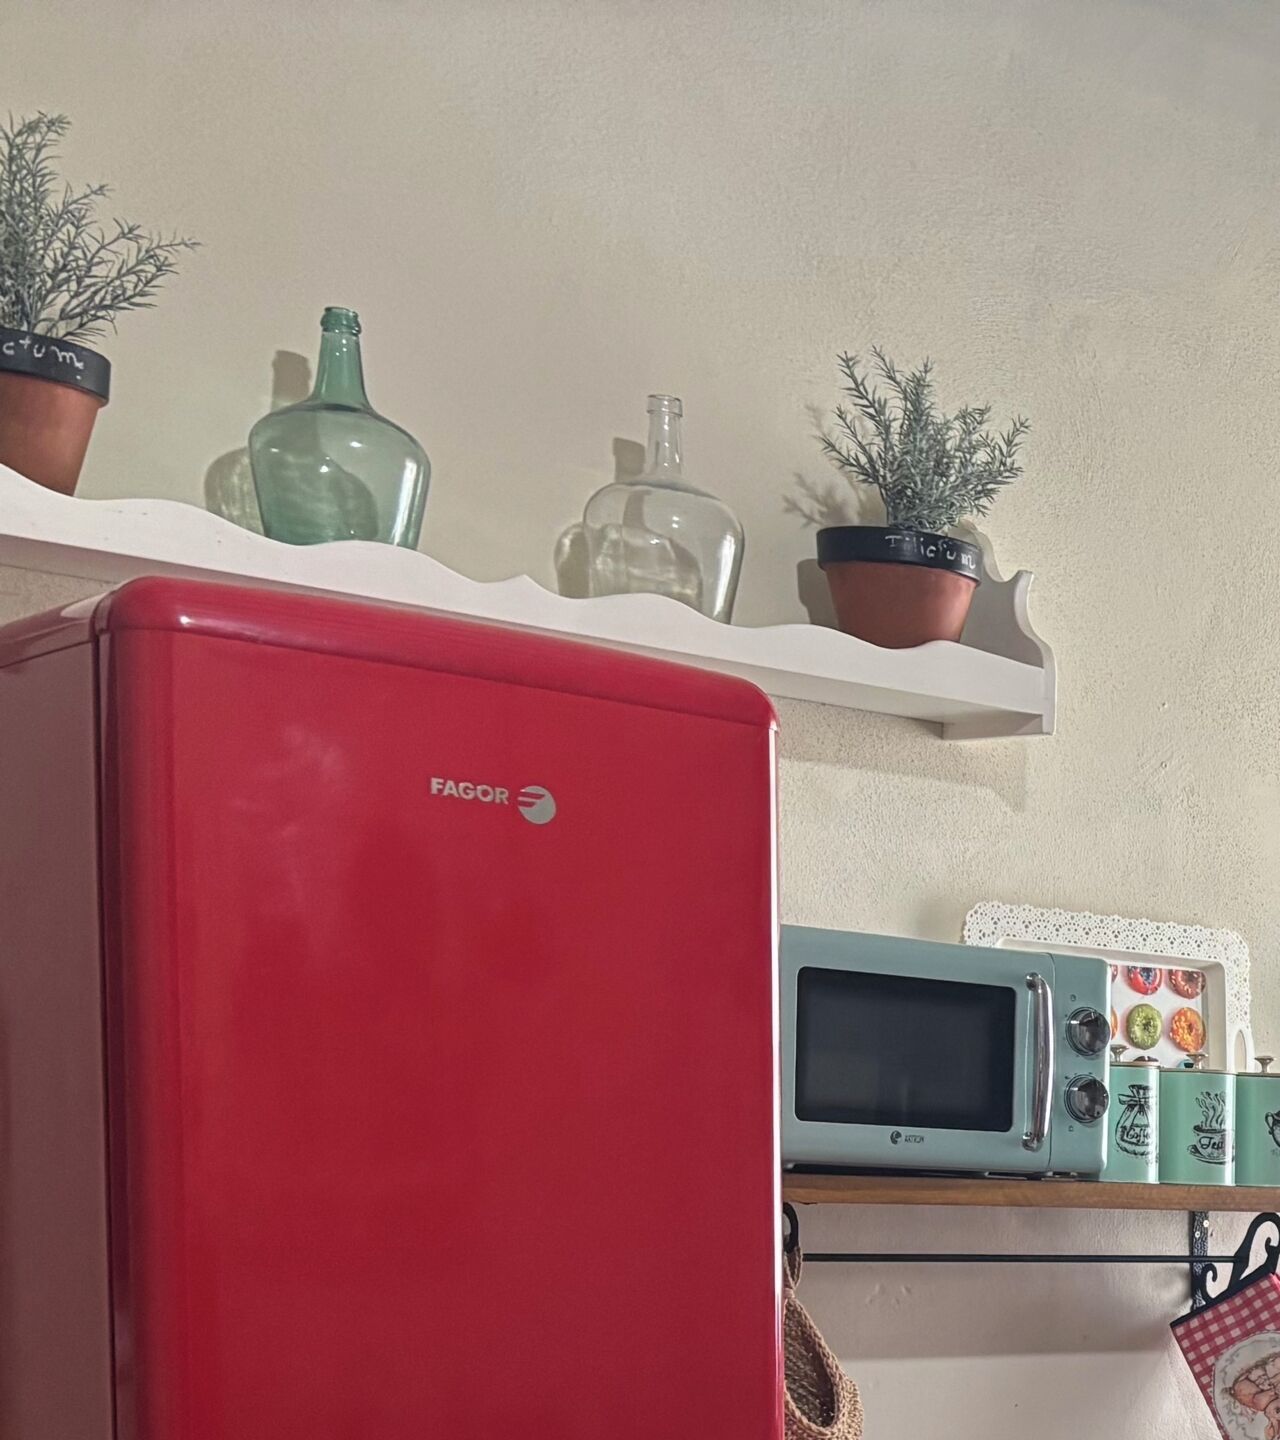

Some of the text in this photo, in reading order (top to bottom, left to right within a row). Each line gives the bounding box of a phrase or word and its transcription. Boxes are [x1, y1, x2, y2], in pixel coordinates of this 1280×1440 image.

[430, 777, 510, 806] FAGOR
[1126, 1127, 1151, 1143] Coffe
[1199, 1135, 1225, 1151] Tea
